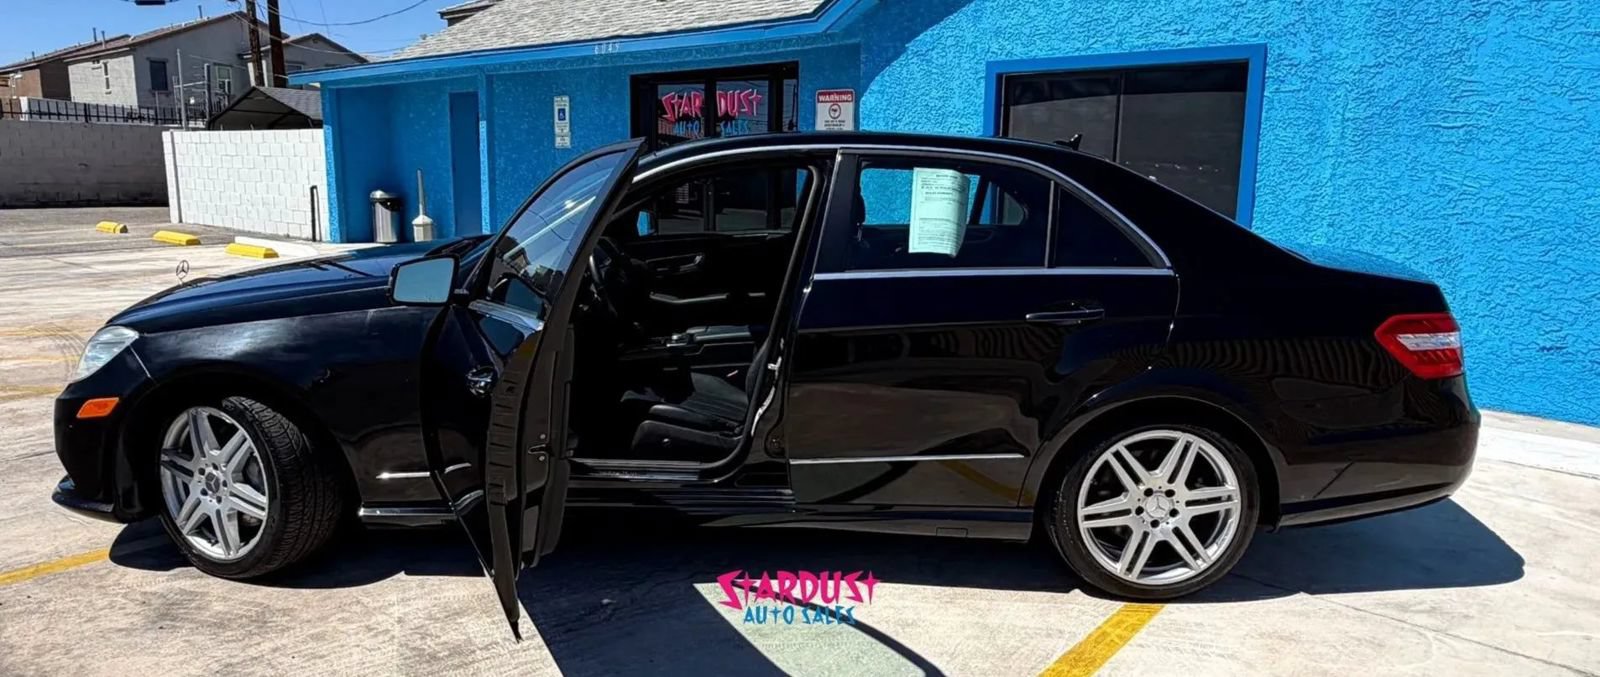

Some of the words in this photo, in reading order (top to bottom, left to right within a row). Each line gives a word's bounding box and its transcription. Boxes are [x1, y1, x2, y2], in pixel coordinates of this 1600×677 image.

[818, 93, 853, 102] WARNING
[673, 119, 700, 136] AUTO
[719, 118, 751, 137] SALES
